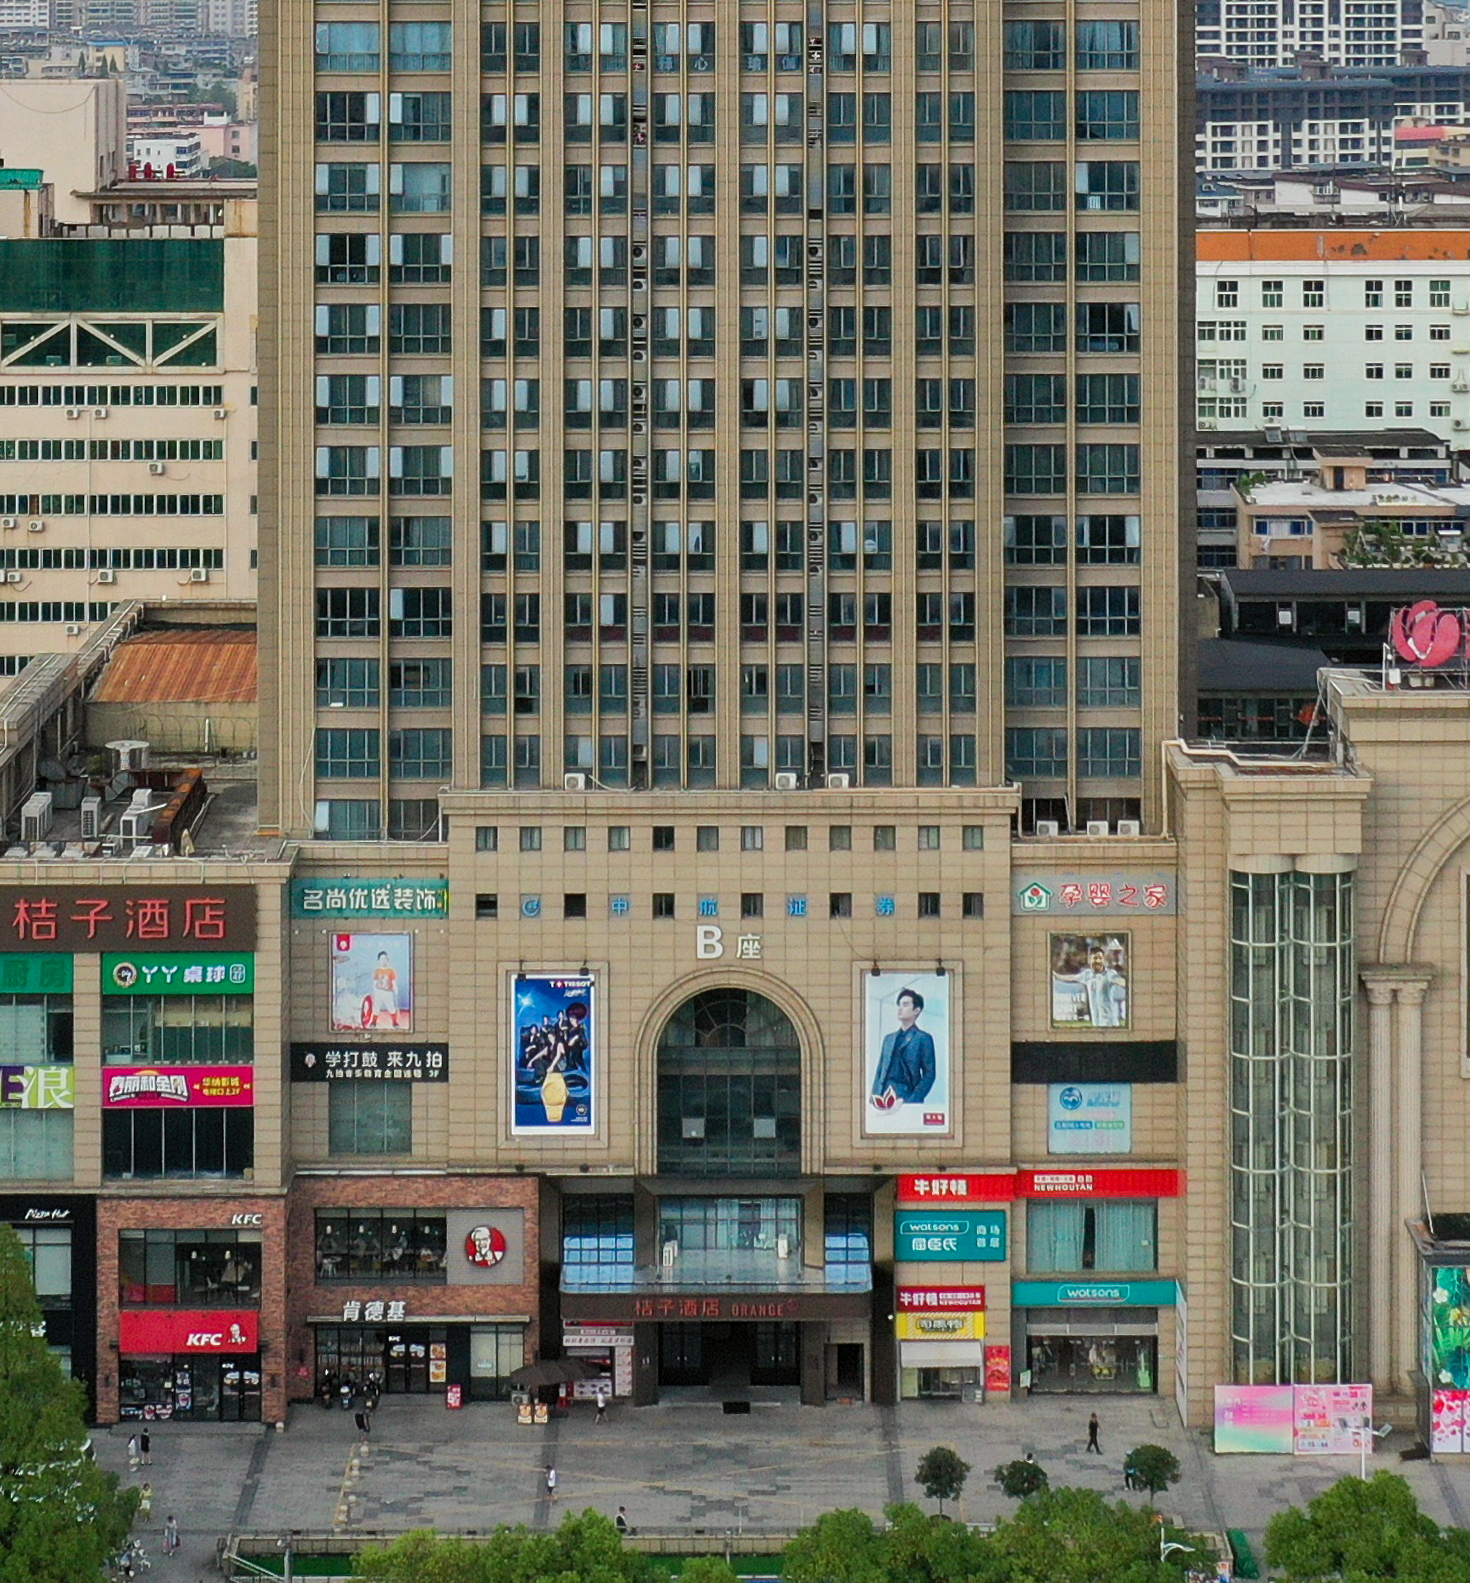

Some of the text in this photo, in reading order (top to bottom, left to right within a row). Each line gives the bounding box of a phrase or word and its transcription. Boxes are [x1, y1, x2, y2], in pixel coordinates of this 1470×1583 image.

[303, 887, 437, 910] 名尚优选装饰
[1059, 882, 1168, 909] 孕婴之家
[611, 895, 896, 916] 中航证券
[12, 897, 228, 940] 桔子酒店
[696, 925, 762, 960] B座
[325, 1050, 443, 1068] 学打鼓 来九拍
[15, 1065, 74, 1108] 浪
[232, 1213, 262, 1225] KFC
[909, 1223, 960, 1231] watsons
[912, 1237, 957, 1251] 屈臣氏
[1067, 1287, 1120, 1297] watsons
[343, 1300, 407, 1322] 肯德基
[635, 1298, 785, 1316] 桔子酒店 ORANGE
[186, 1333, 223, 1346] KFC
